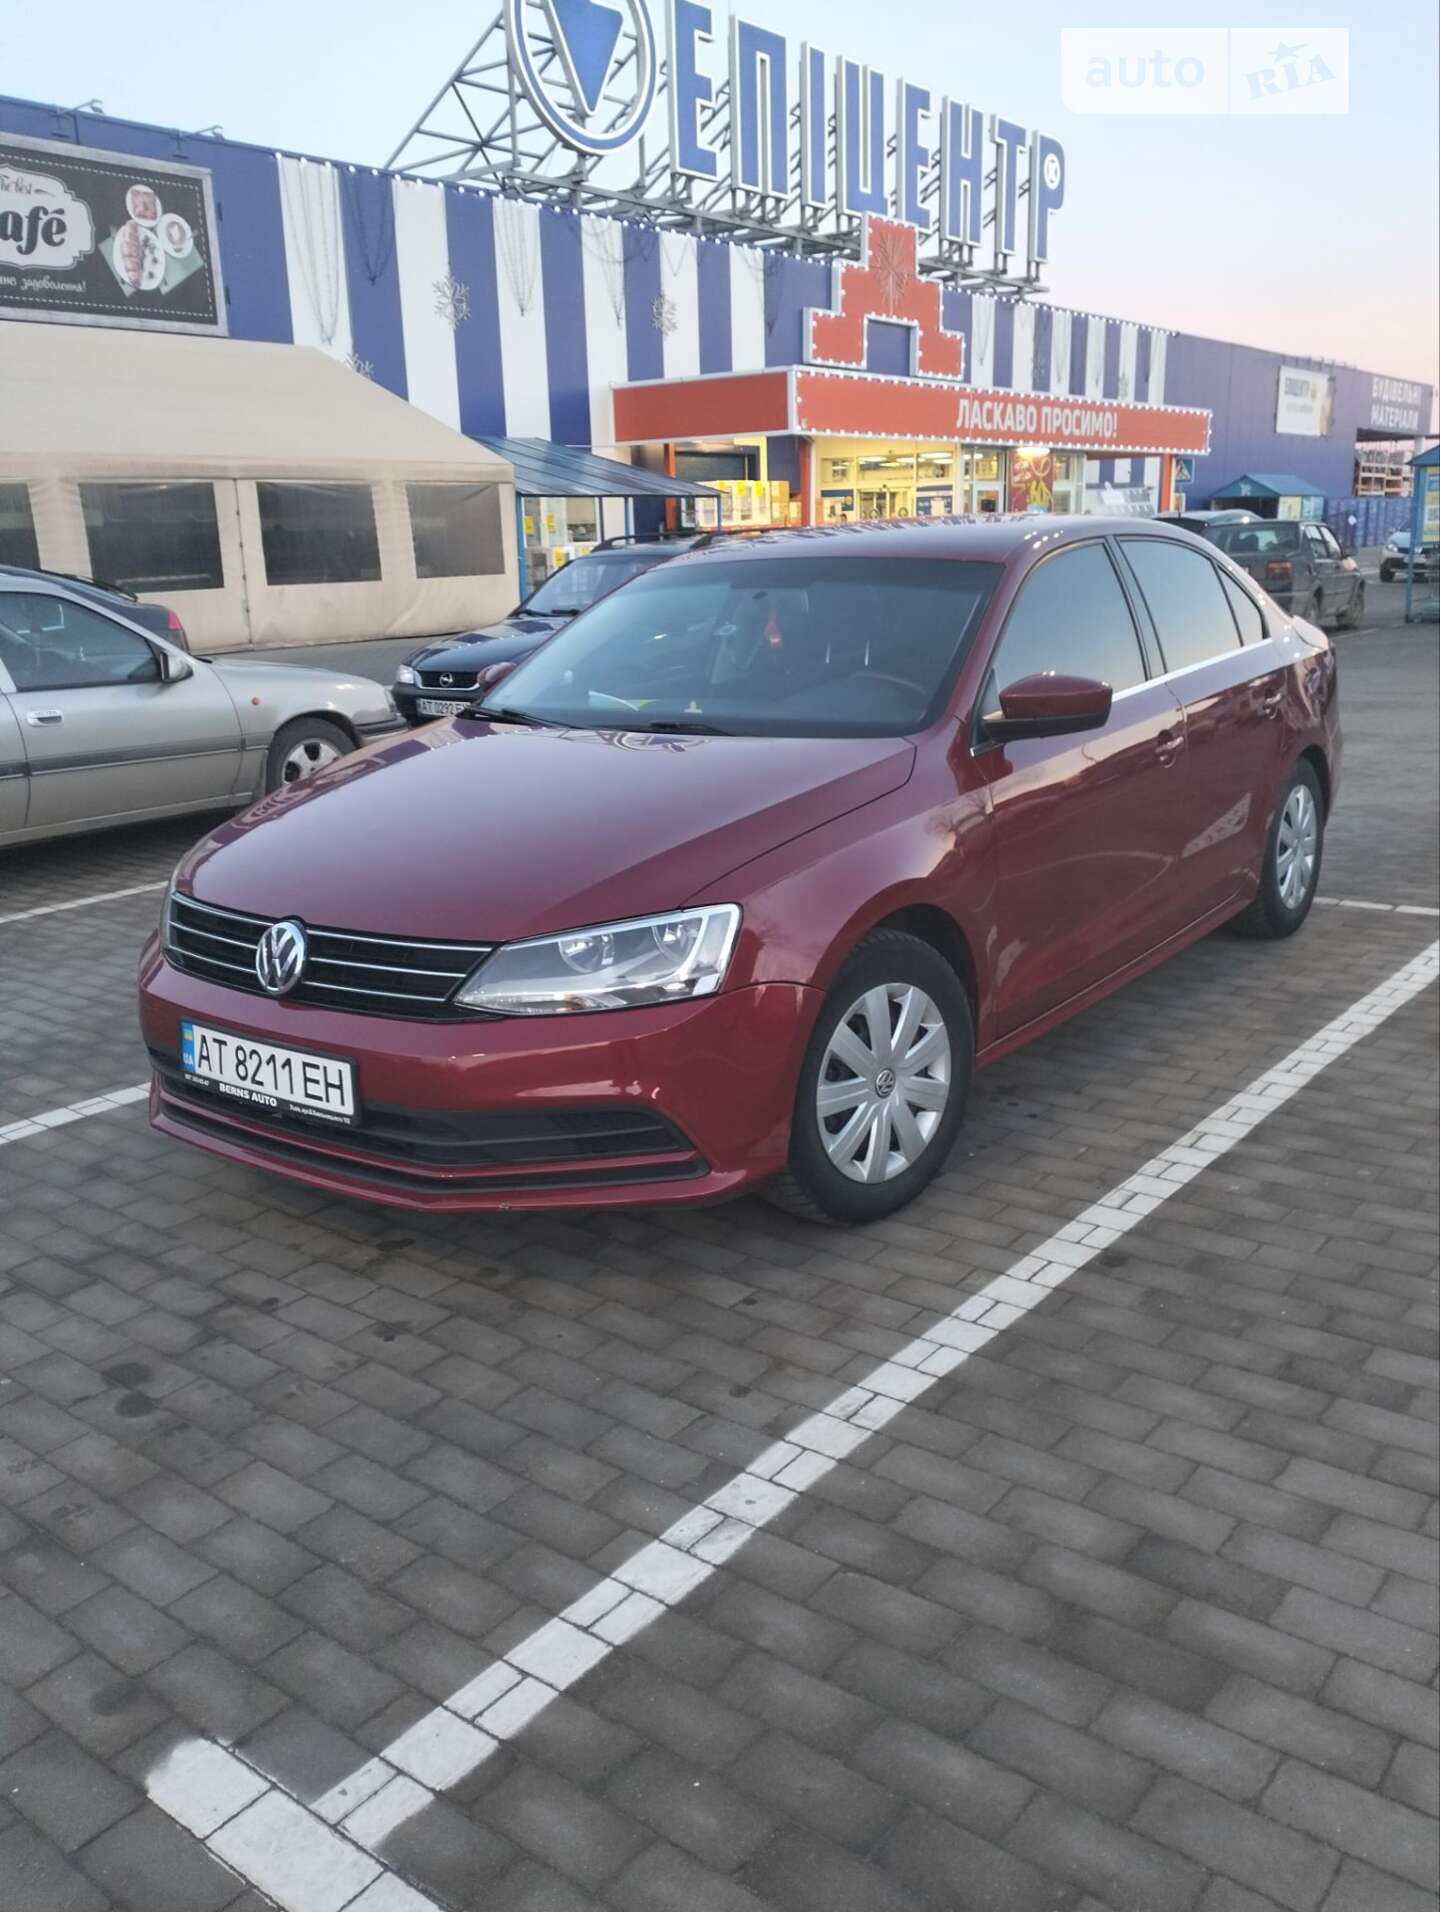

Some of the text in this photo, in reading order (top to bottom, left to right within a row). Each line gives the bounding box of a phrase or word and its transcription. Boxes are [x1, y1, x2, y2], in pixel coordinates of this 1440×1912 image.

[665, 0, 1067, 264] ЕПІЦЕНТР
[956, 398, 1118, 438] ЛАСКАВО ПРОСИМО!
[198, 1034, 345, 1106] AT 8211 EH
[219, 1082, 278, 1107] BERNS AUTO
